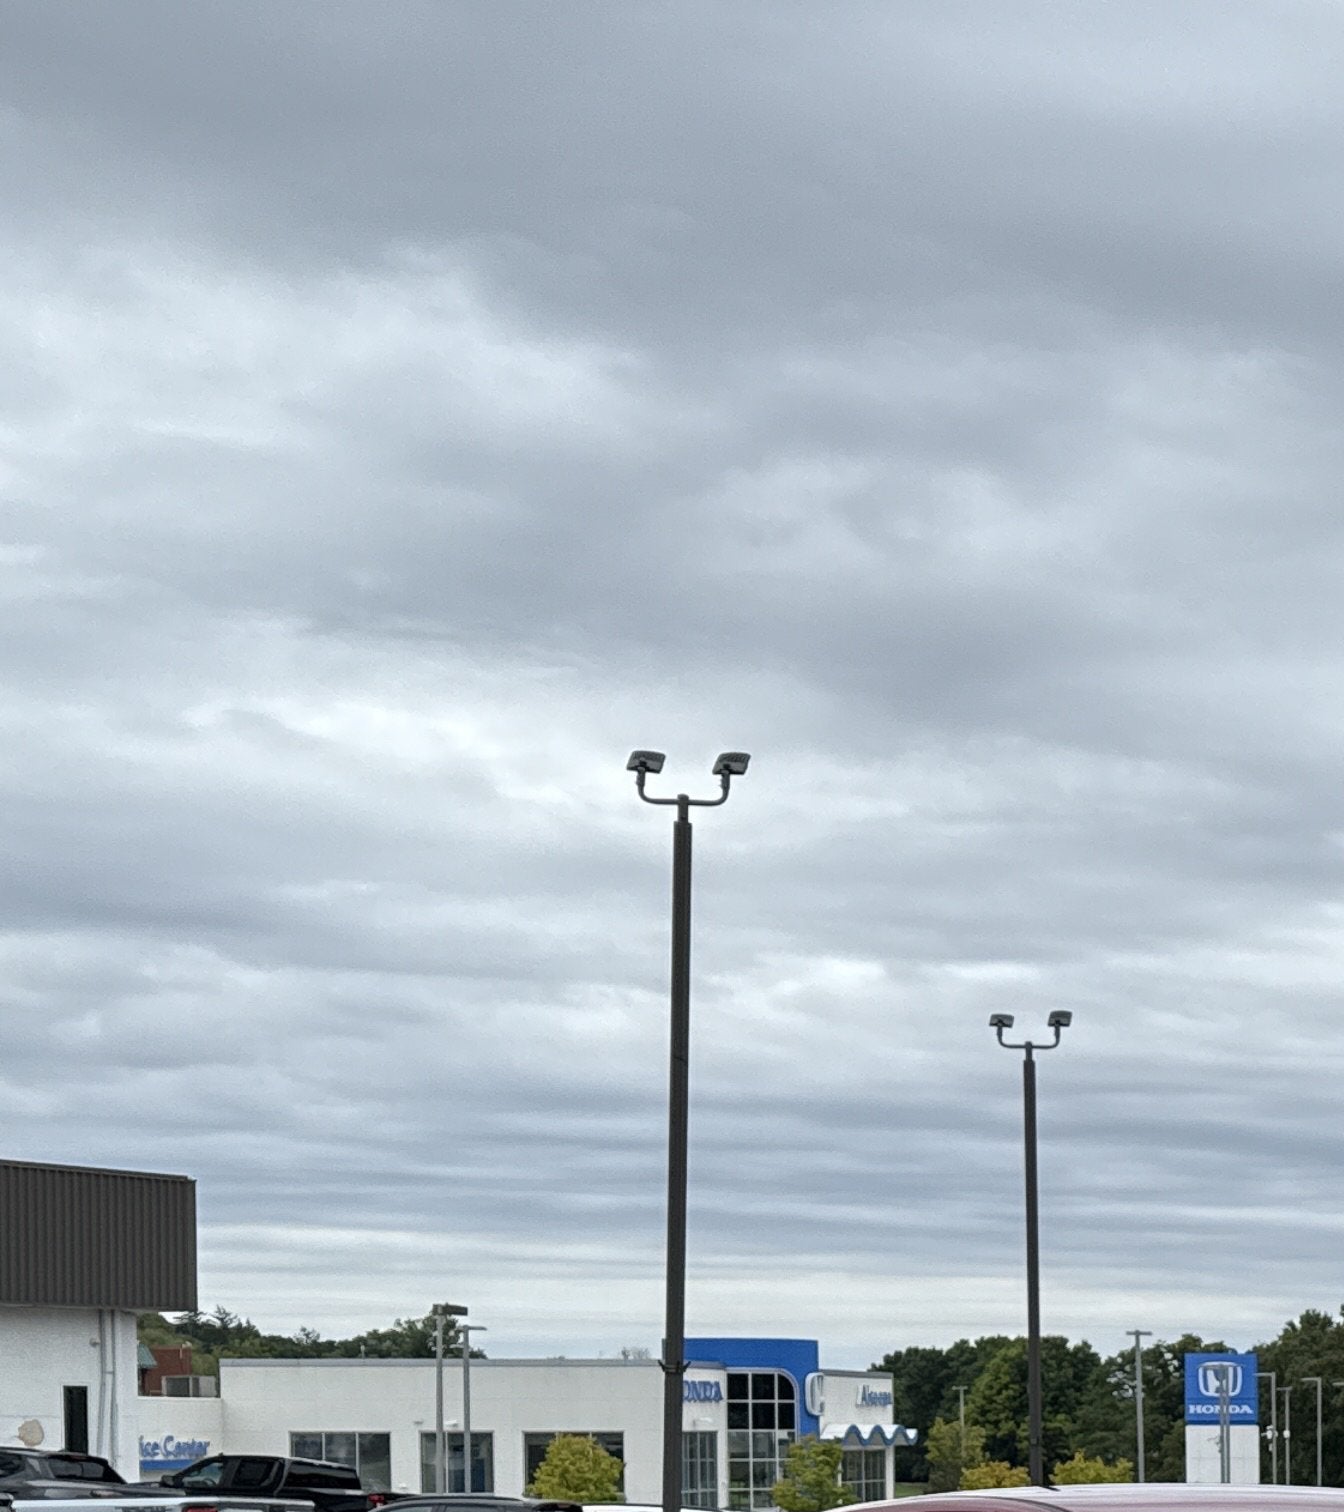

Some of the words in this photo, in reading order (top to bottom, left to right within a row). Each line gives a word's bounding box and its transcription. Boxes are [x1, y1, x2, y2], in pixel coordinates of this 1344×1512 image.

[682, 1380, 724, 1403] ONDA
[1188, 1404, 1254, 1414] HONDA
[138, 1435, 160, 1457] ice
[163, 1434, 210, 1458] Center
